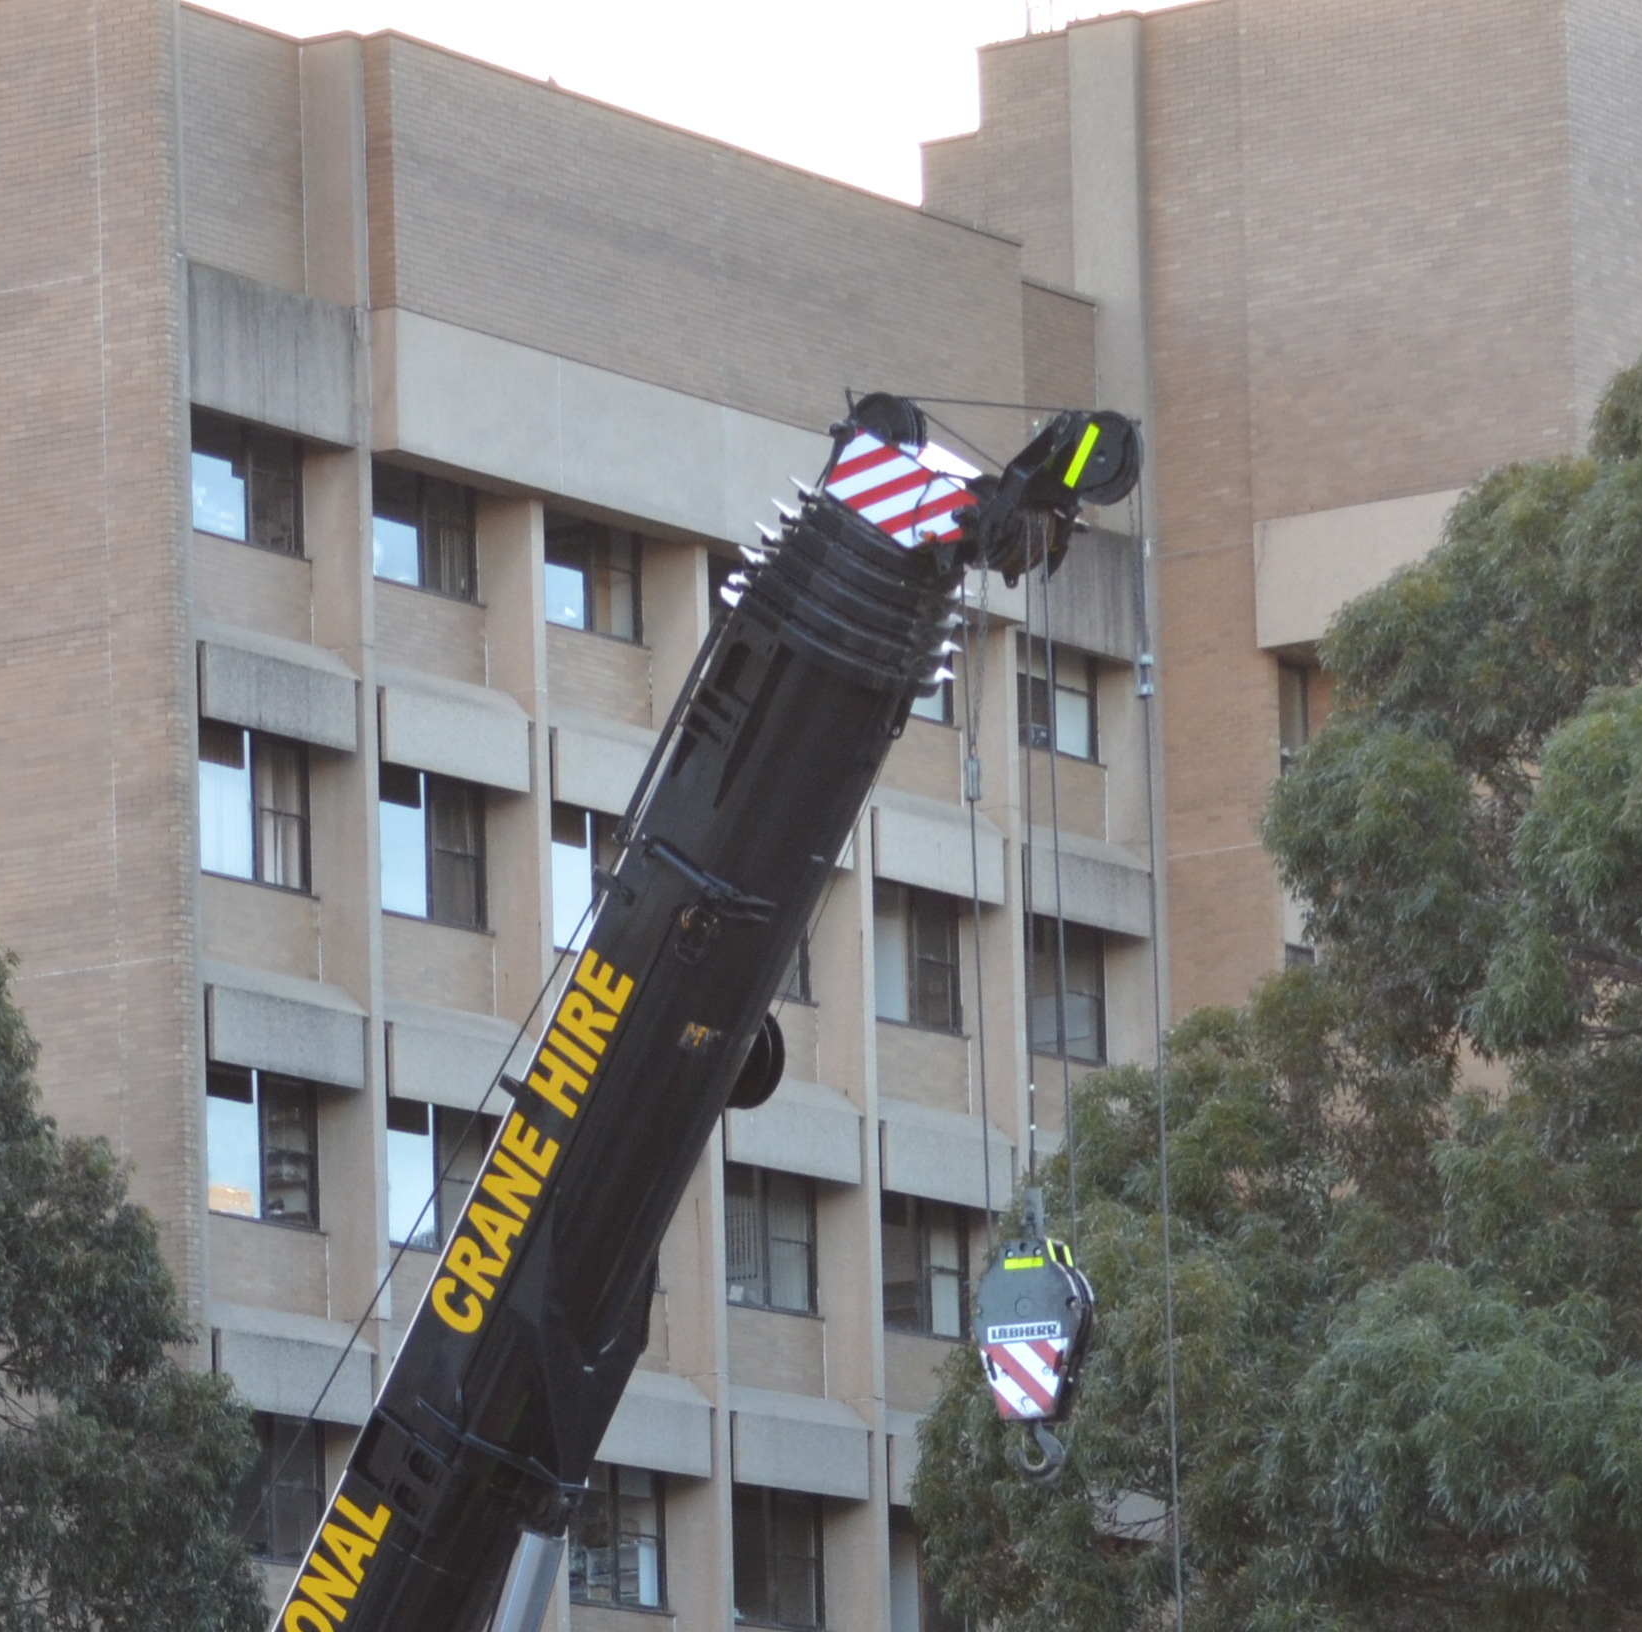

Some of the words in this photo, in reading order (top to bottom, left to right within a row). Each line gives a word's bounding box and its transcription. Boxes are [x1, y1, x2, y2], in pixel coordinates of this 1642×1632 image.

[431, 1111, 560, 1335] CRANE
[526, 948, 634, 1119] HIRE
[990, 1323, 1058, 1340] LIEBHERR
